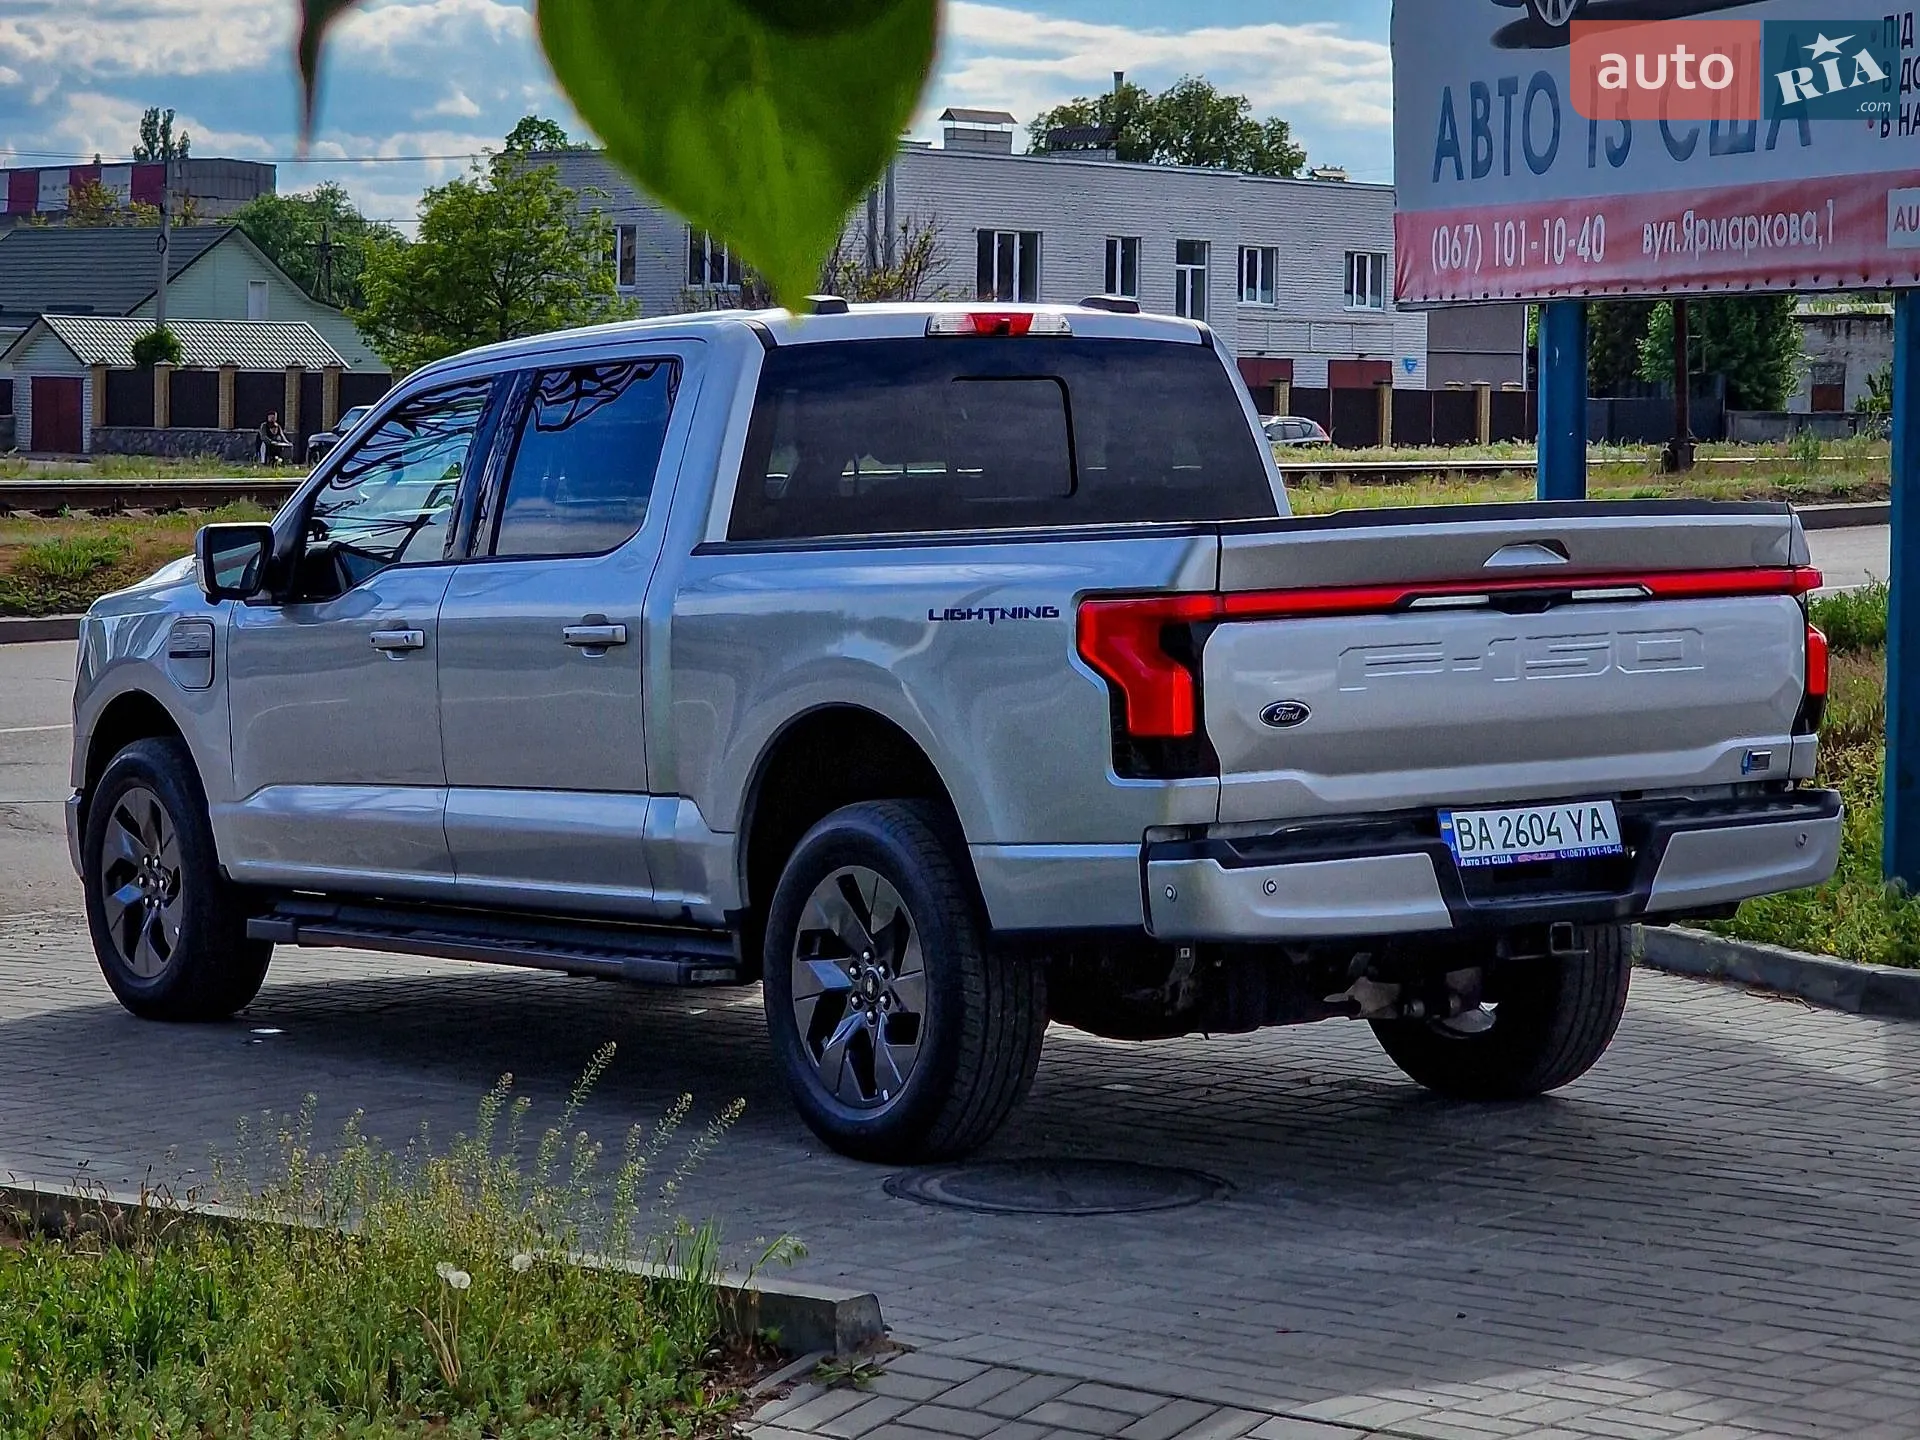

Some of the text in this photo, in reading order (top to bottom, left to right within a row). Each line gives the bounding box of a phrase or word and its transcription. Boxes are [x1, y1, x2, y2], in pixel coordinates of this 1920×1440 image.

[1882, 12, 1914, 50] ПІД
[1432, 33, 1813, 184] АВТО ІЗ США
[1432, 223, 1482, 275] (067)
[1493, 214, 1606, 267] 101-10-40
[927, 606, 1060, 625] LIGHTNING
[1337, 627, 1704, 692] F-150
[1273, 707, 1302, 721] Ford
[1455, 807, 1609, 851] BA 2604 YA
